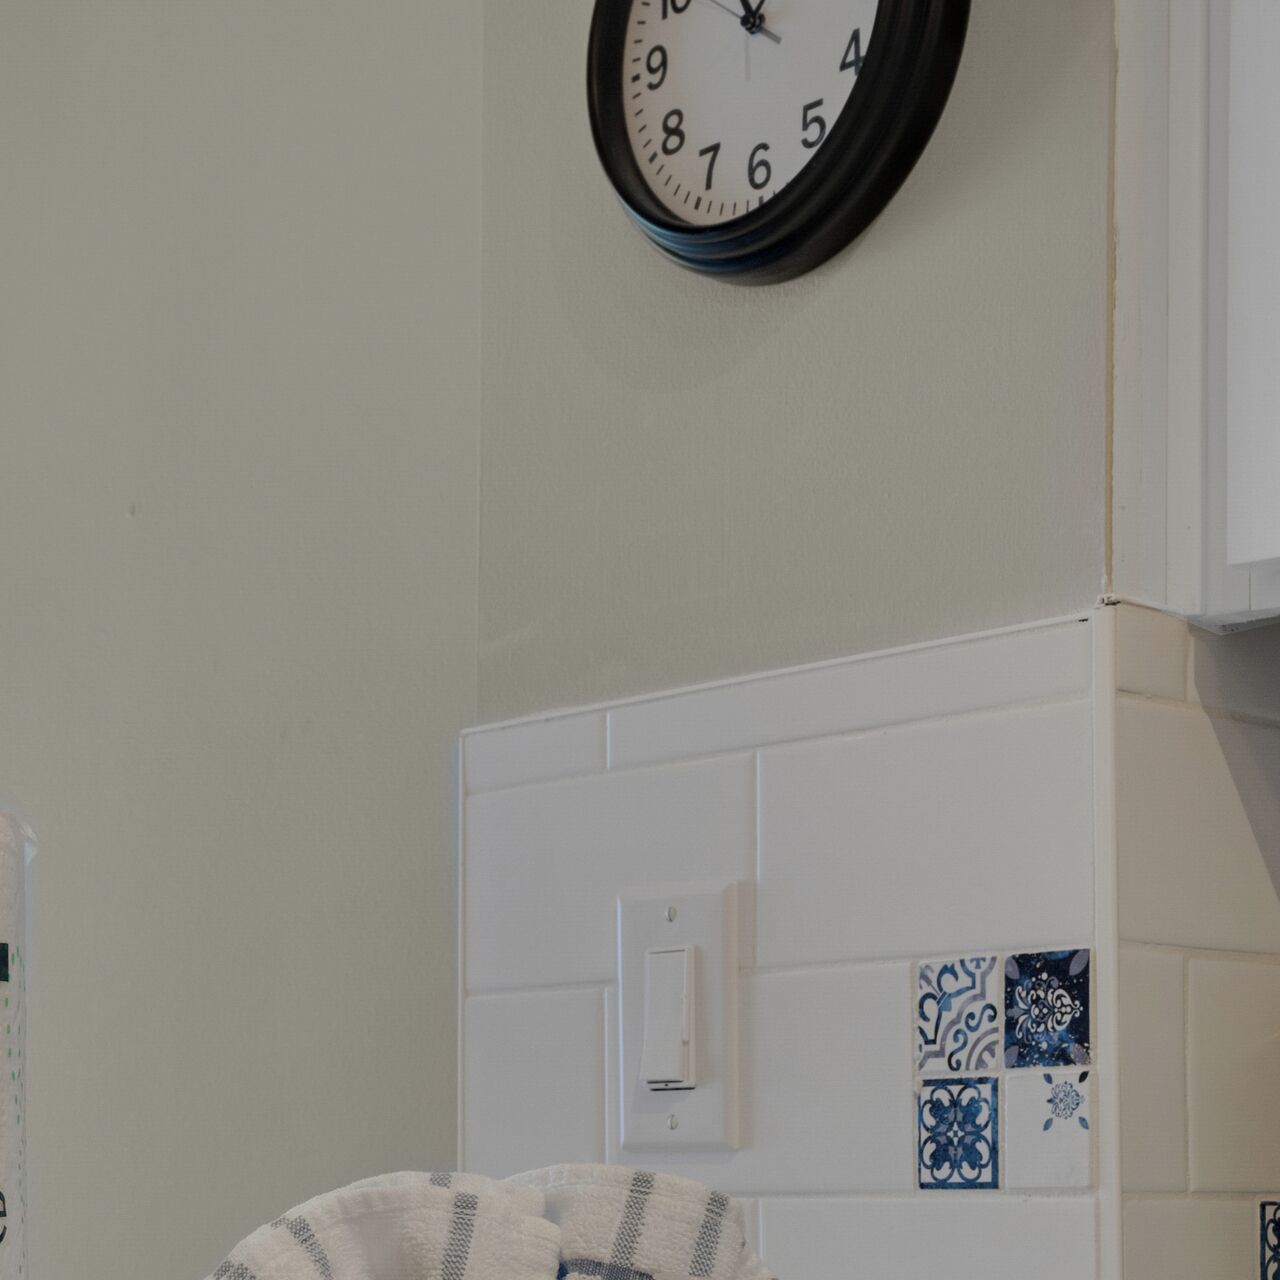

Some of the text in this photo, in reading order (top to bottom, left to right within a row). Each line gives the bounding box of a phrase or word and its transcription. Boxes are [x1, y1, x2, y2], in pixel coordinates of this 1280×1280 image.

[646, 44, 668, 91] 9
[839, 28, 865, 77] 4
[661, 109, 686, 156] 8
[801, 98, 826, 149] 5
[698, 142, 721, 191] 7
[747, 142, 772, 190] 6
